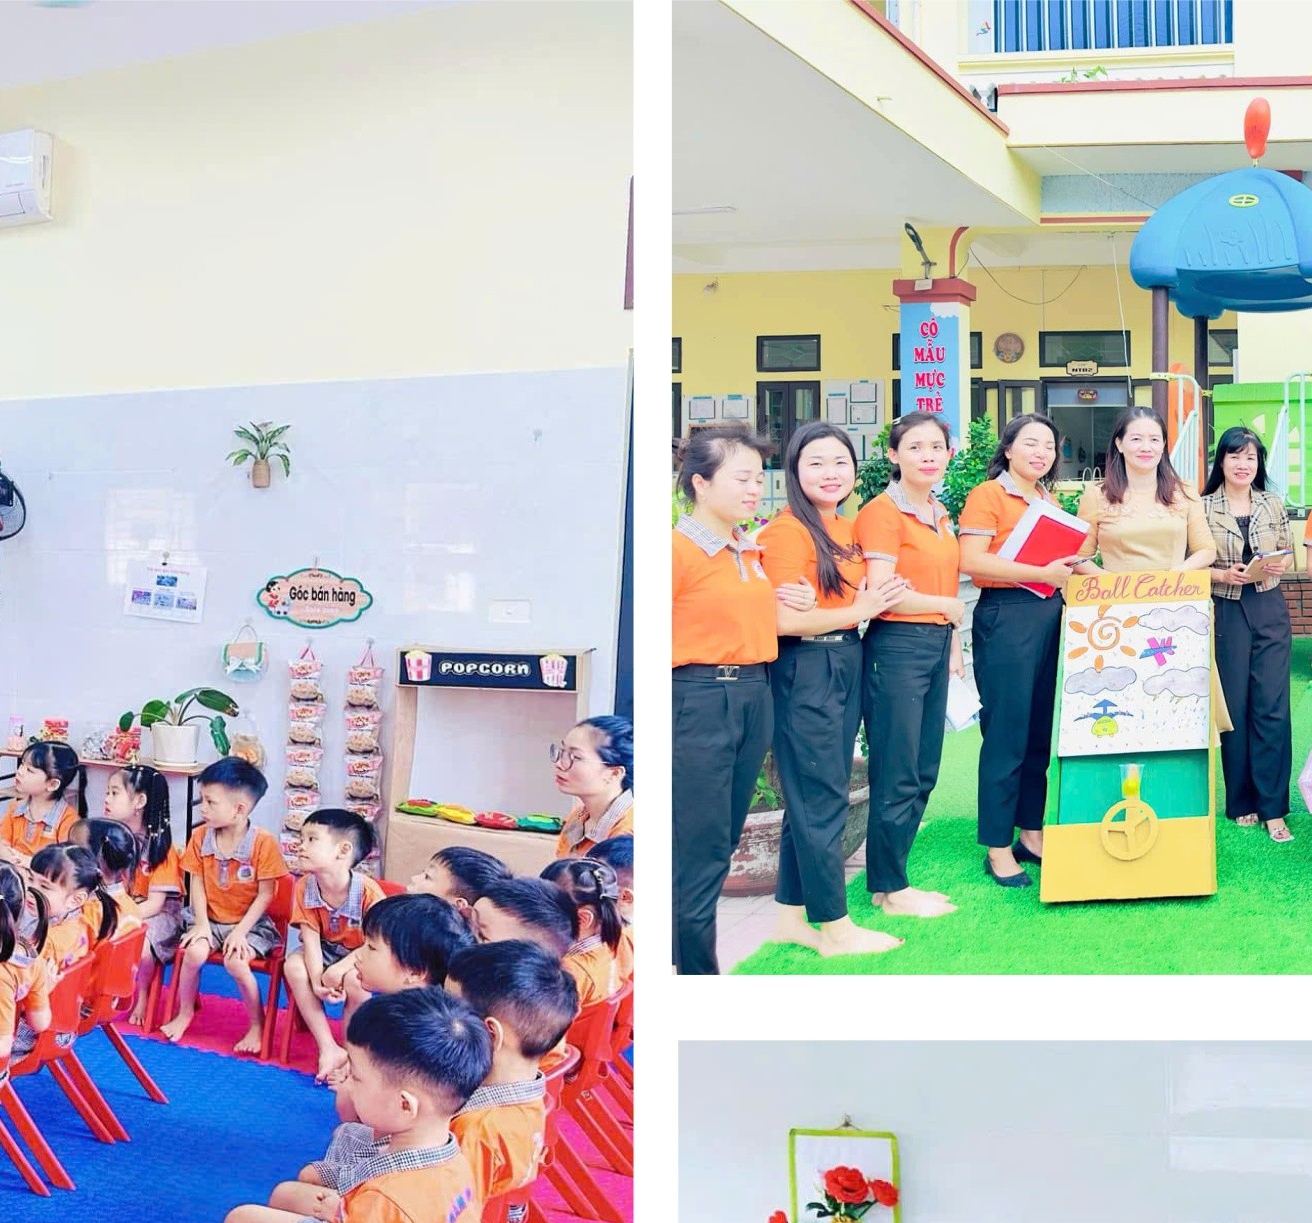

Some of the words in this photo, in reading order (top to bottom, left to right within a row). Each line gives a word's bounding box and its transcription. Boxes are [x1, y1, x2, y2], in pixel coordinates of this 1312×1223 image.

[920, 317, 938, 337] CÔ
[914, 338, 945, 362] MẪU
[915, 369, 945, 390] MỰC
[916, 391, 943, 412] TRẺ
[289, 585, 309, 600] Góc
[311, 585, 329, 601] bán
[332, 587, 356, 606] hàng
[1076, 576, 1132, 602] Ball
[1134, 572, 1205, 599] Catcher
[440, 661, 531, 676] POPCORN
